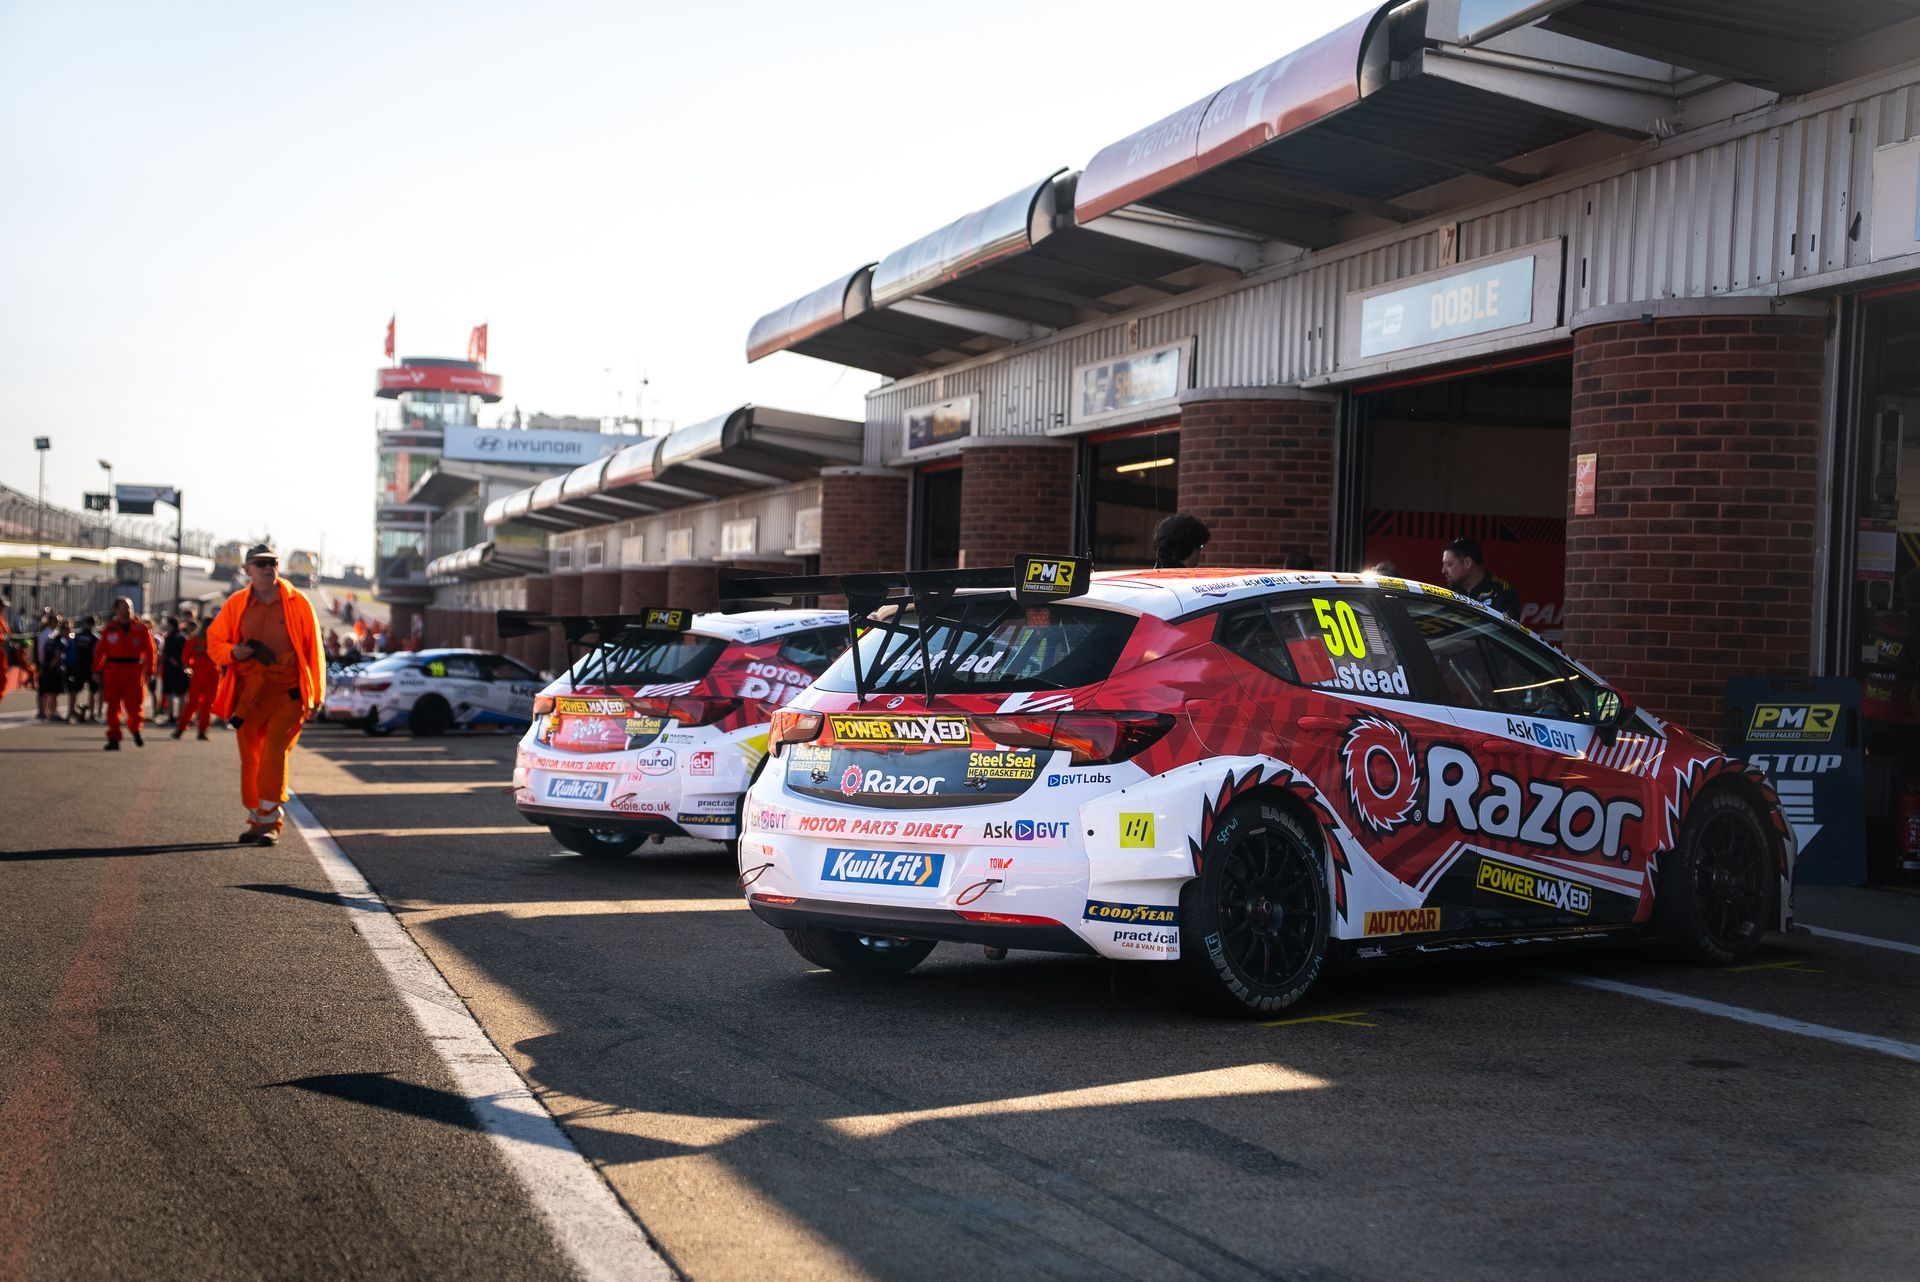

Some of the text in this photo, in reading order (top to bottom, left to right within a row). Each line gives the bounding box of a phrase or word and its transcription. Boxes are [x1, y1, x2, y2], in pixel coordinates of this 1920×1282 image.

[1430, 279, 1500, 330] DOBLE
[506, 439, 583, 454] HYUNDAI
[1027, 562, 1072, 583] PMR
[649, 612, 679, 623] PMR
[1312, 598, 1366, 659] 50
[745, 661, 813, 688] MOTOR
[560, 701, 624, 715] POWER MAXED
[1755, 707, 1834, 728] PMR
[835, 717, 966, 744] POWER MAXED
[1507, 717, 1577, 752] Ask GVT
[536, 758, 616, 770] MOTOR PARTS DIRECT
[639, 757, 672, 767] eurol
[969, 753, 1036, 768] Steel Seal
[1748, 754, 1843, 774] STOP
[968, 769, 1032, 778] HEAD GASKET FIX
[1426, 744, 1643, 858] Razor
[769, 814, 786, 828] GVT
[798, 816, 963, 839] MOTOR PARTS DIRECT
[983, 822, 1069, 839] Ask GVT
[989, 858, 1003, 869] TOW
[1479, 864, 1590, 914] POWER MAXED
[1366, 912, 1437, 934] AUTOCAR
[1114, 930, 1178, 944] practical
